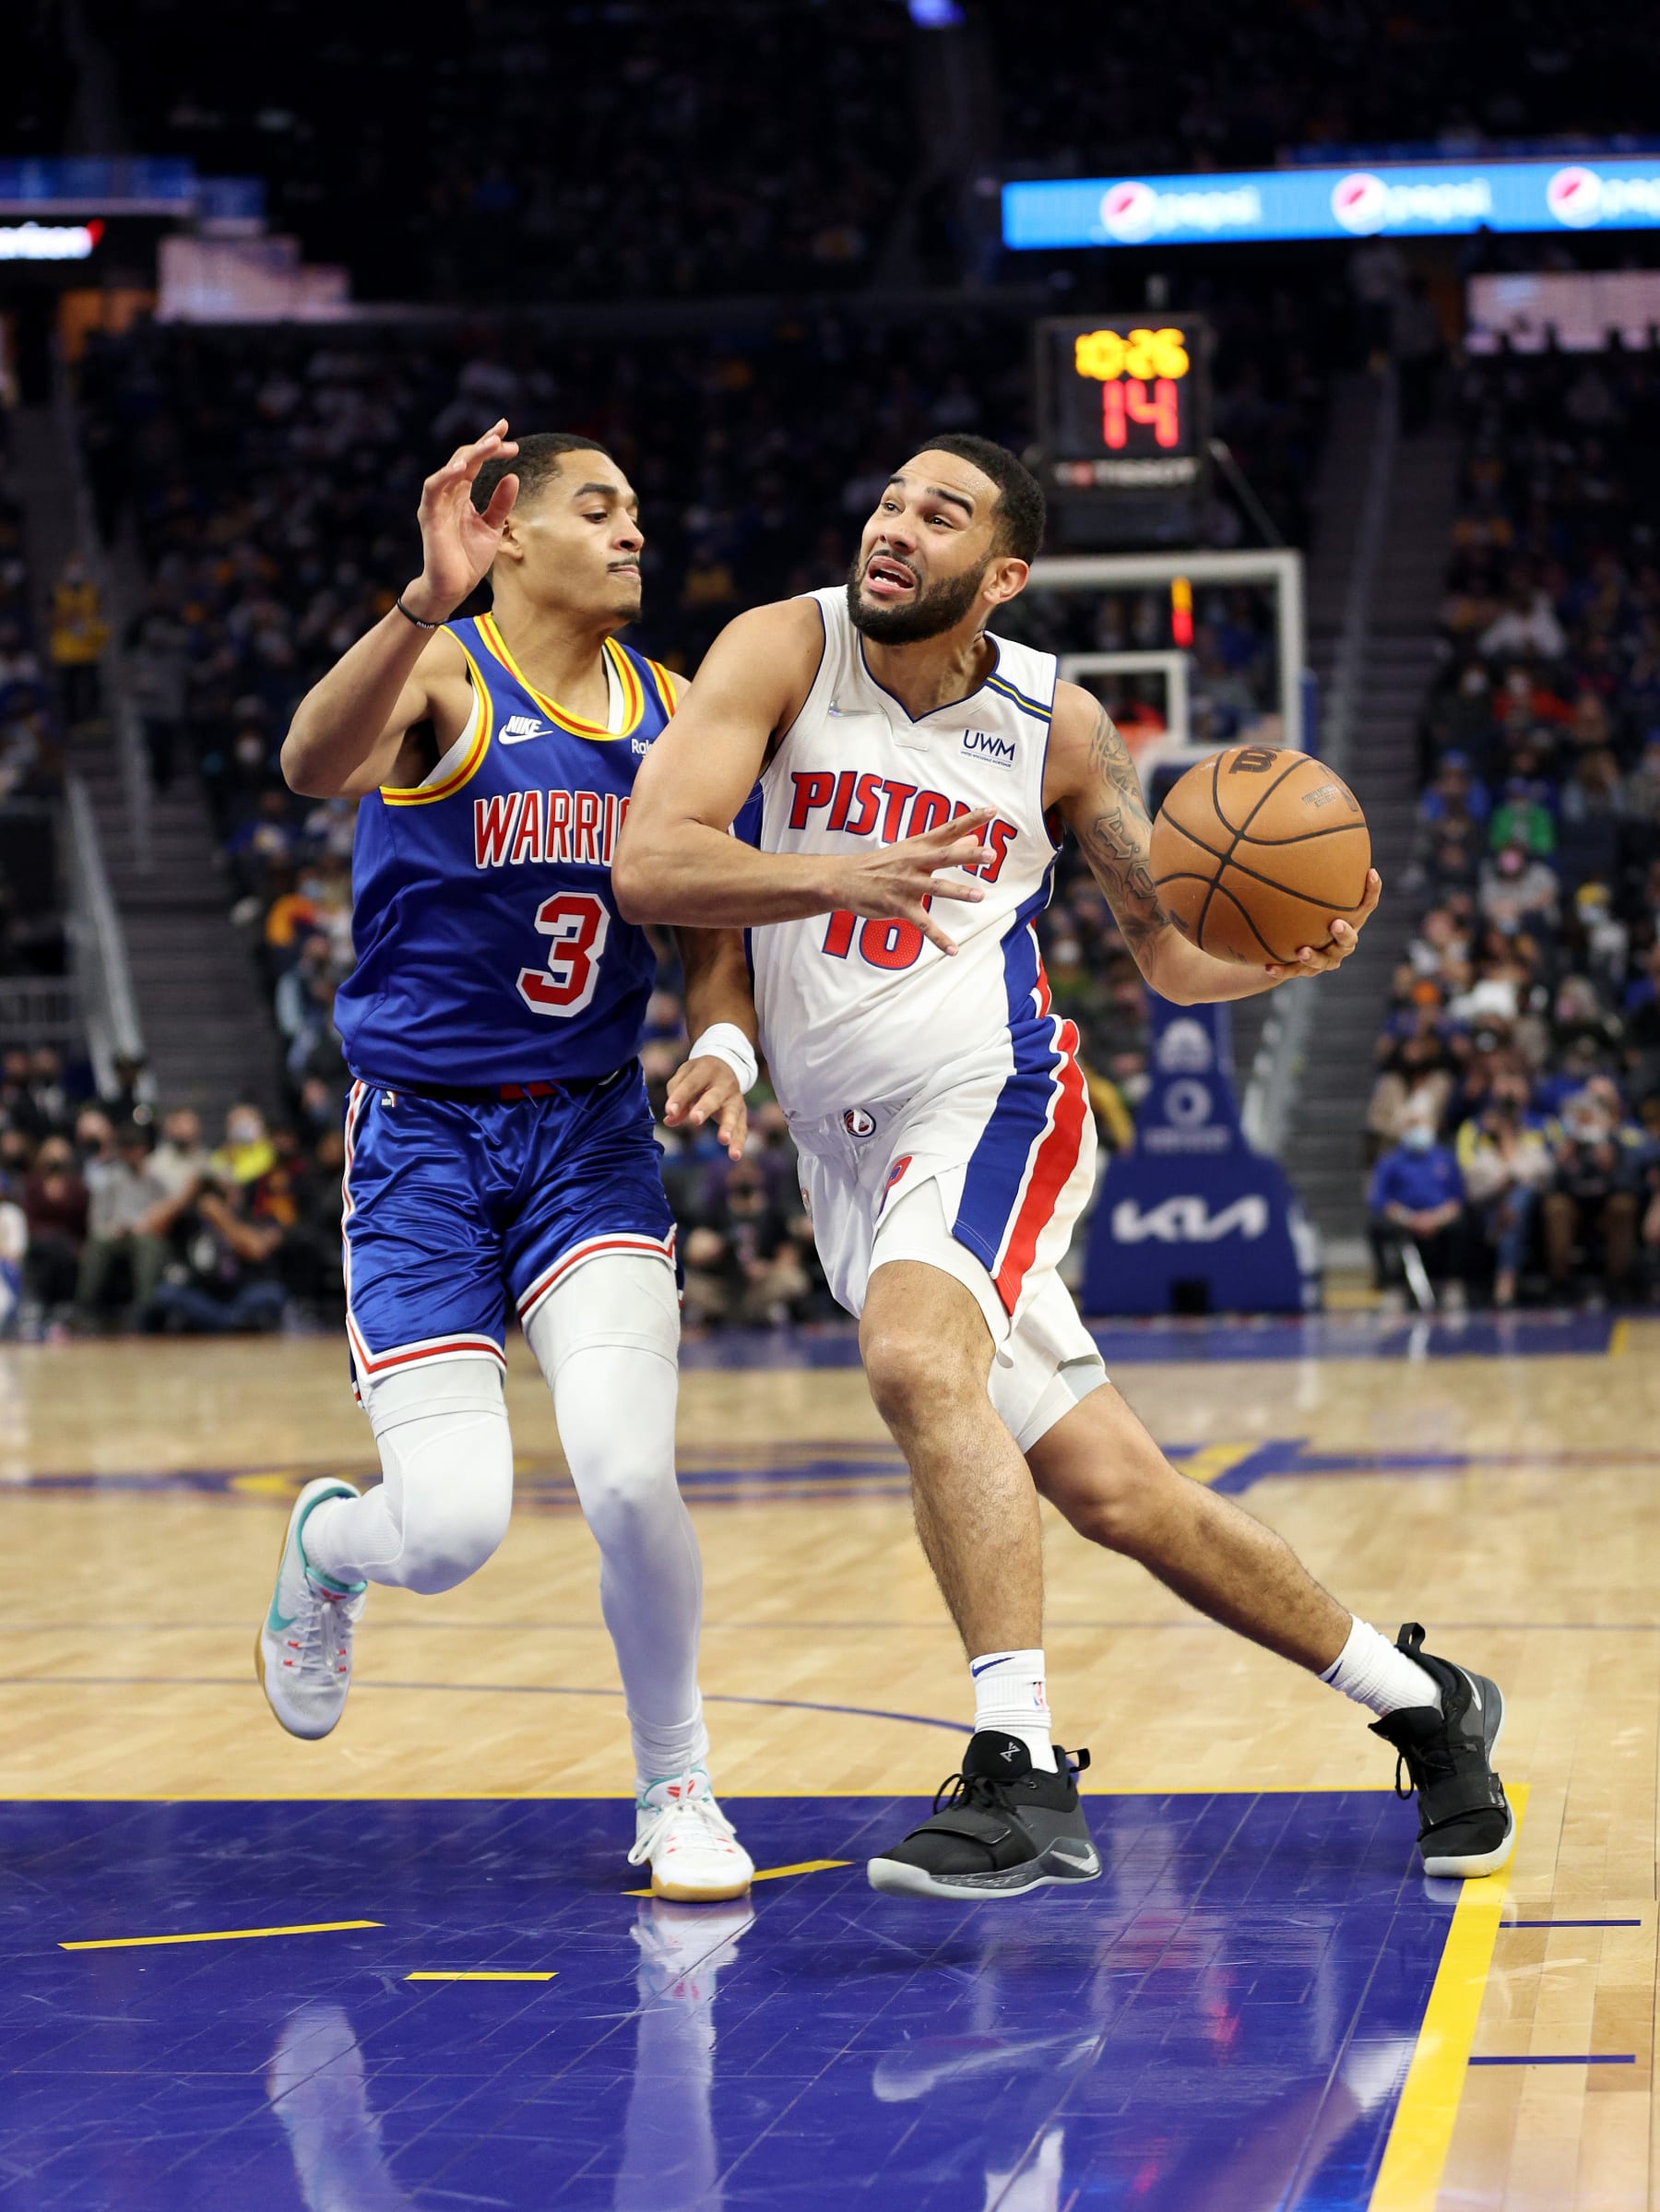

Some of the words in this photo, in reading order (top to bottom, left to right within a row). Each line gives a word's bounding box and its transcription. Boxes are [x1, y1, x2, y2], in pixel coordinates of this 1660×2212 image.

[1102, 378, 1179, 449] 14
[506, 715, 542, 735] NIKE
[963, 729, 1016, 761] UWM
[516, 891, 611, 1017] 3
